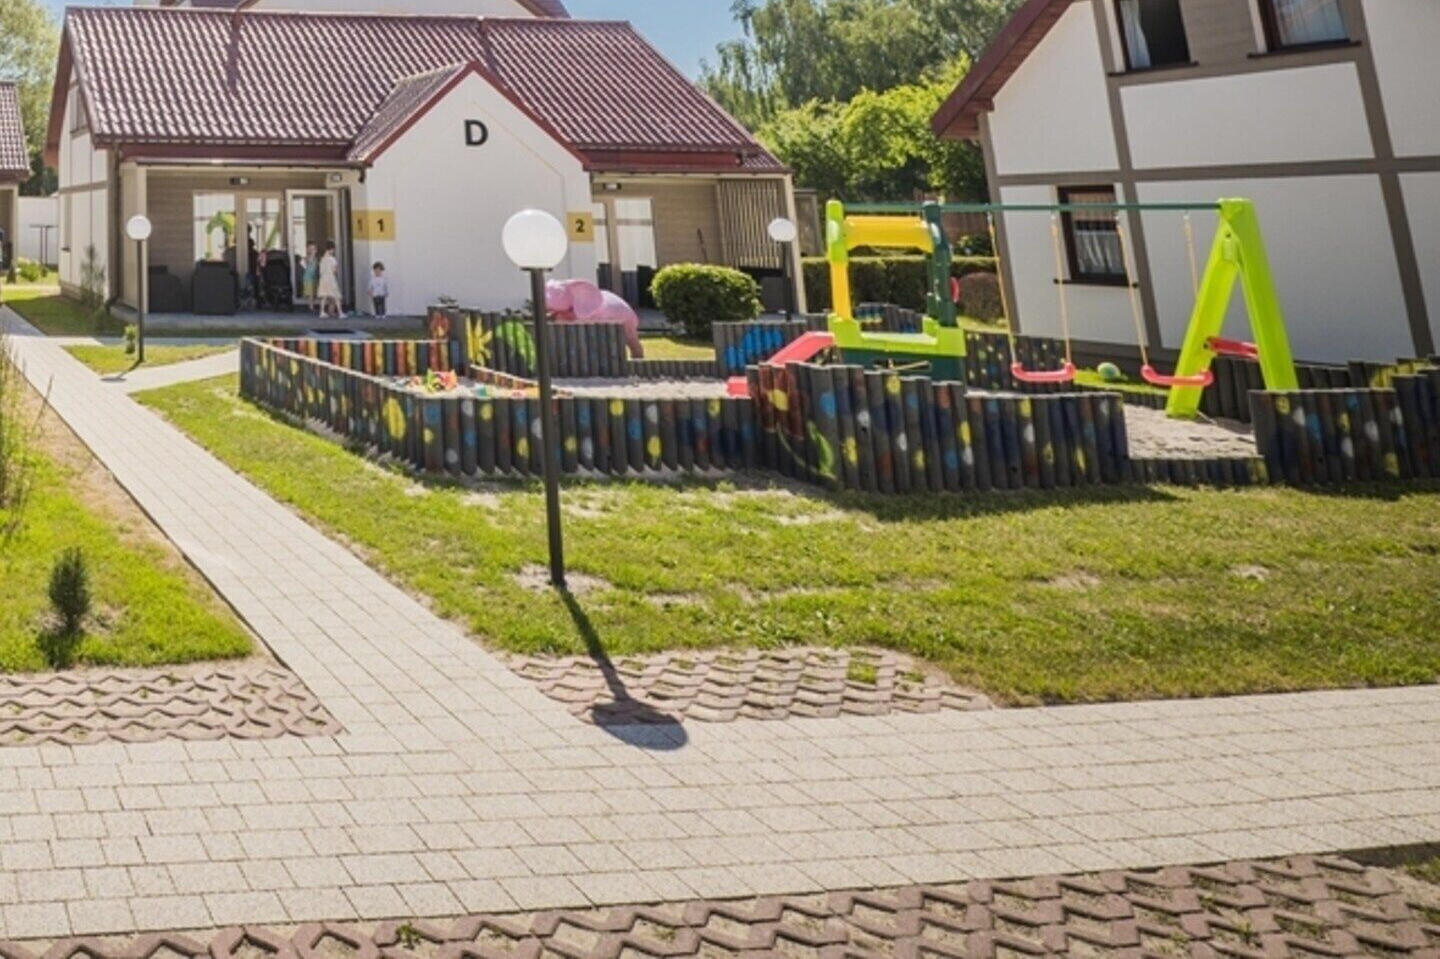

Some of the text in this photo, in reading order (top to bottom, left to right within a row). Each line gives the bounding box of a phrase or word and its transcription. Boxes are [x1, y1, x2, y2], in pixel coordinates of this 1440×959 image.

[464, 119, 489, 147] D
[376, 218, 385, 233] 1
[575, 218, 586, 233] 2
